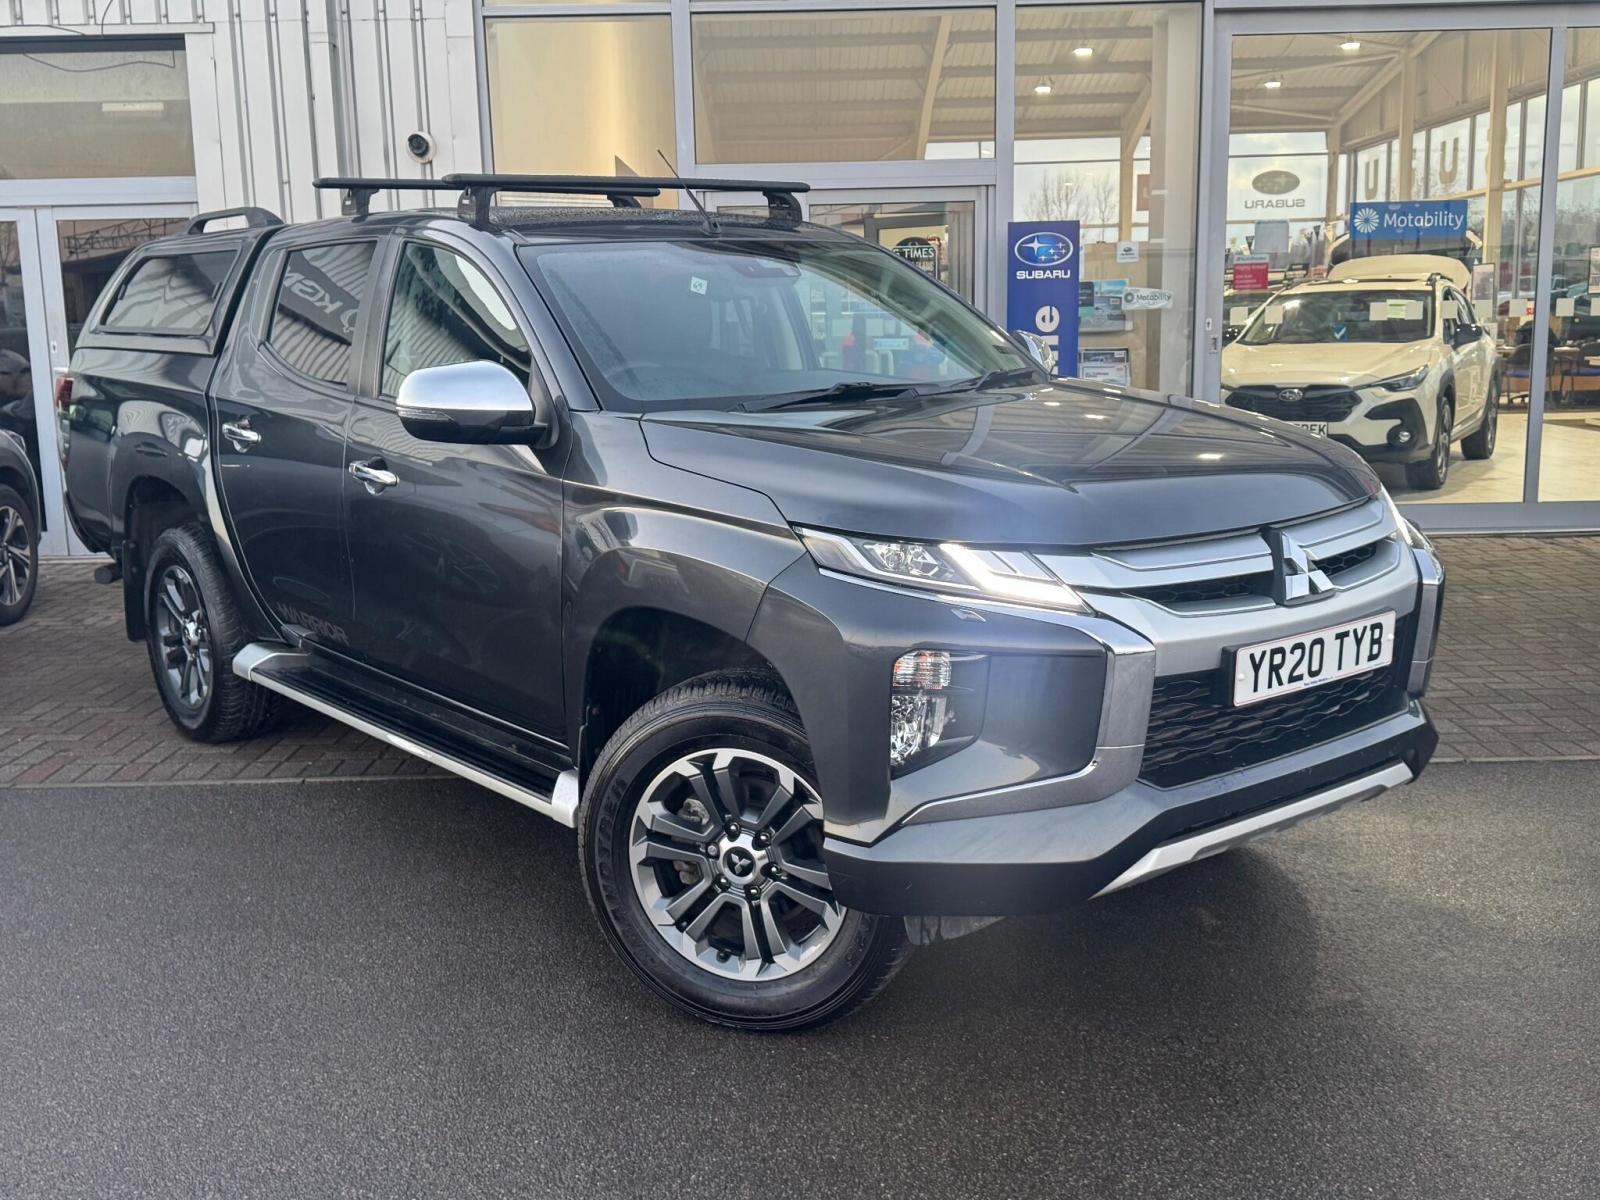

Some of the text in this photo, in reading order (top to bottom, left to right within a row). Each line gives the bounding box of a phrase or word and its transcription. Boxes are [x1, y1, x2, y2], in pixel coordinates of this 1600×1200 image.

[1383, 211, 1464, 230] Motability
[903, 247, 934, 258] TIMES
[1016, 269, 1071, 280] SUBARU
[1249, 622, 1384, 693] YR20 TYB
